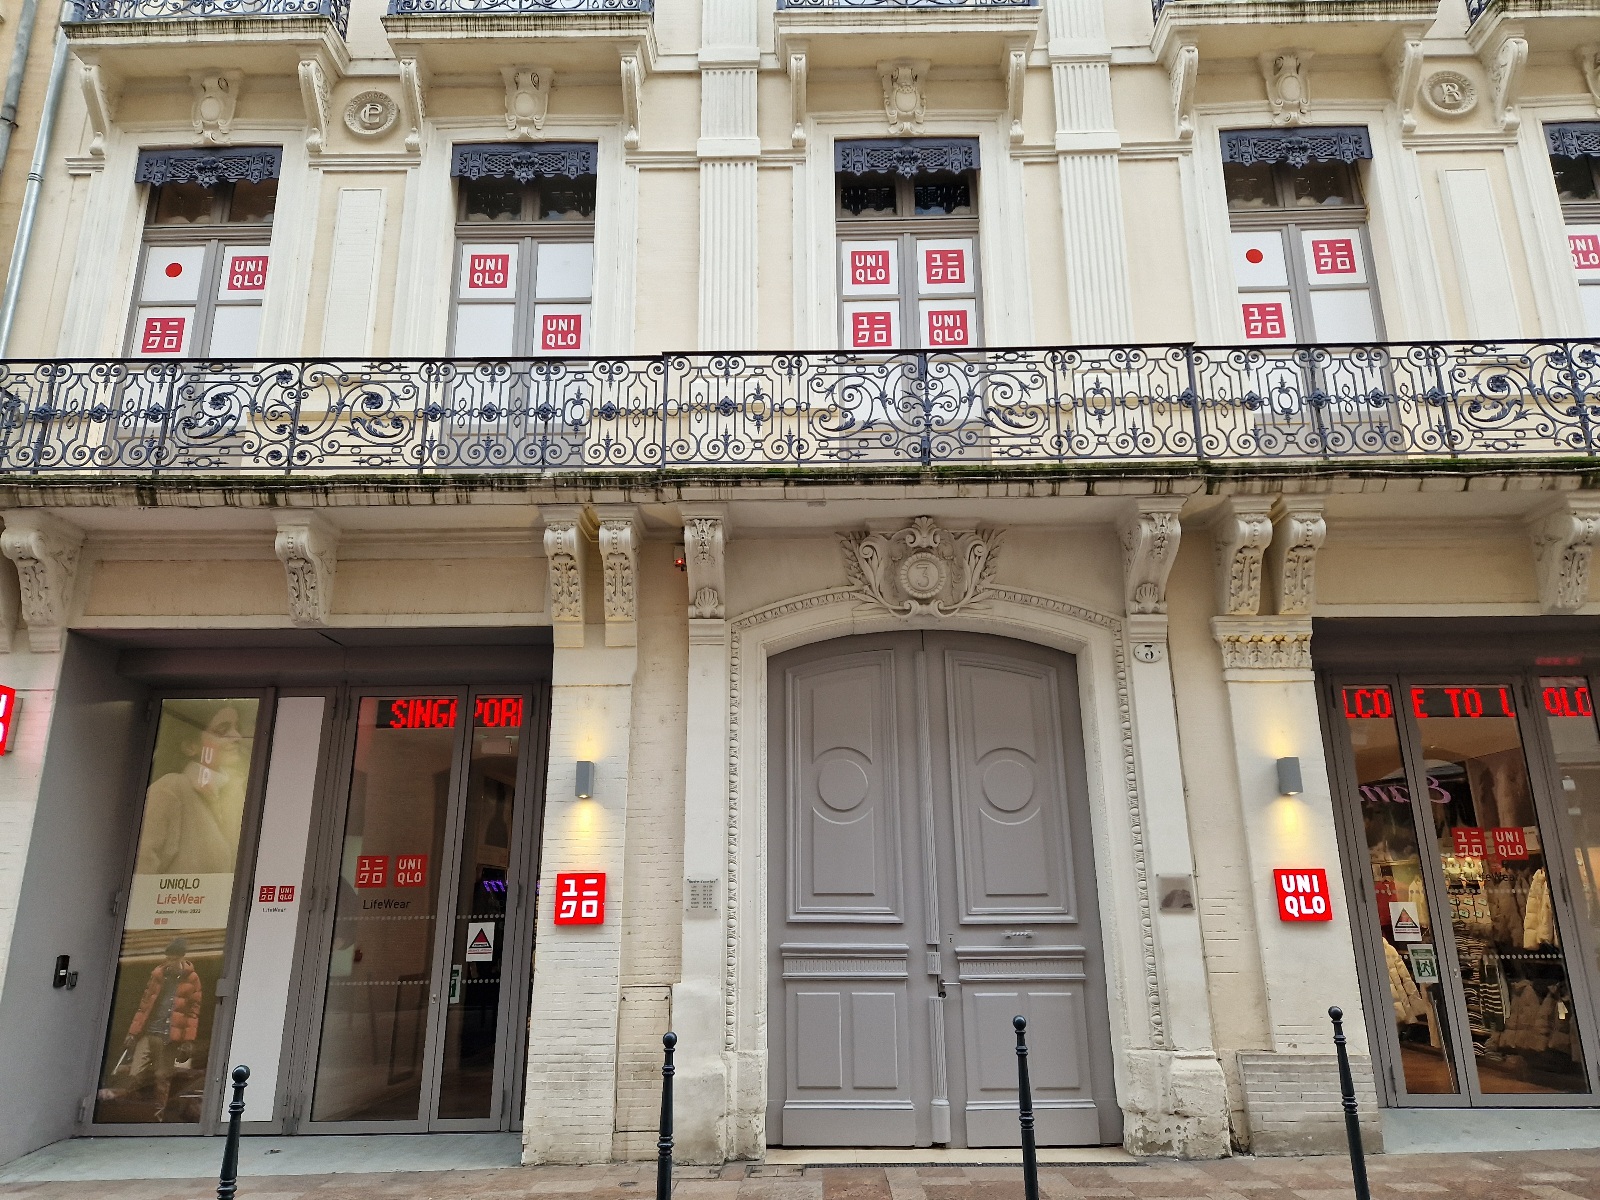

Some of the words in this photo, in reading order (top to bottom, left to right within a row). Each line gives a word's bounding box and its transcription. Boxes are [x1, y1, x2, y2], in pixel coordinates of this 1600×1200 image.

[1318, 243, 1348, 256] ユニ
[474, 258, 502, 271] UNI
[855, 254, 883, 267] UNI
[931, 253, 959, 265] ユニ
[1320, 257, 1351, 270] クロ
[234, 260, 263, 272] UNI
[473, 272, 504, 287] QLO
[855, 268, 886, 283] QLO
[930, 267, 960, 280] クロ
[232, 274, 263, 288] QLO
[1248, 307, 1279, 320] ユニ
[547, 318, 575, 331] UNI
[857, 316, 886, 328] ユニ
[932, 314, 960, 327] UNI
[150, 321, 179, 334] ユニ
[1249, 321, 1281, 335] クロ
[146, 336, 178, 349] クロ
[546, 333, 577, 347] QLO
[857, 330, 887, 343] クロ
[933, 328, 964, 344] QLO
[916, 564, 930, 588] 3
[1144, 644, 1154, 660] 3
[1444, 688, 1483, 718] TO
[1457, 831, 1481, 842] ユニ
[1495, 831, 1519, 843] UNI
[1498, 844, 1524, 858] QLO
[360, 859, 383, 870] ユニ
[398, 858, 422, 870] UNI
[159, 878, 200, 890] UNIQLO
[358, 872, 383, 884] クロ
[397, 871, 422, 885] QLO
[1281, 874, 1320, 893] UNI
[562, 878, 599, 896] ユニ
[156, 893, 205, 905] LifeWear
[362, 899, 411, 910] LifeWear
[559, 900, 598, 918] クロ
[1284, 895, 1326, 918] QLO
